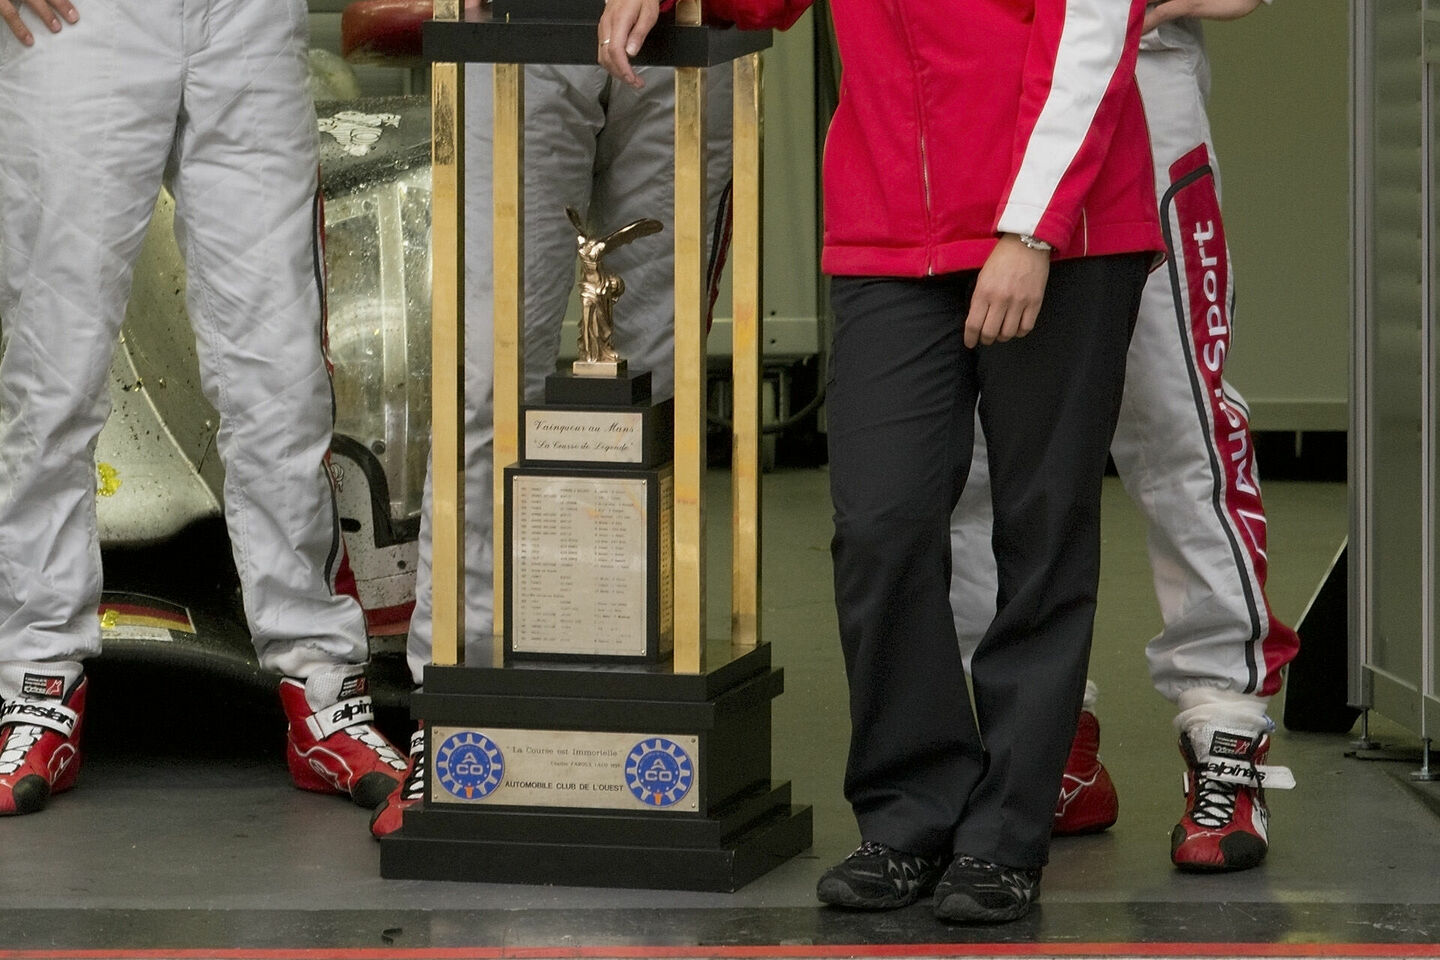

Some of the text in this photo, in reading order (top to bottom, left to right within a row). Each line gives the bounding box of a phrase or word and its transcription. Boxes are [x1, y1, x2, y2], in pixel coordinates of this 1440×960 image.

[1193, 219, 1228, 373] Sport
[505, 781, 553, 790] AUTOMOBILE
[556, 783, 576, 791] CLUB
